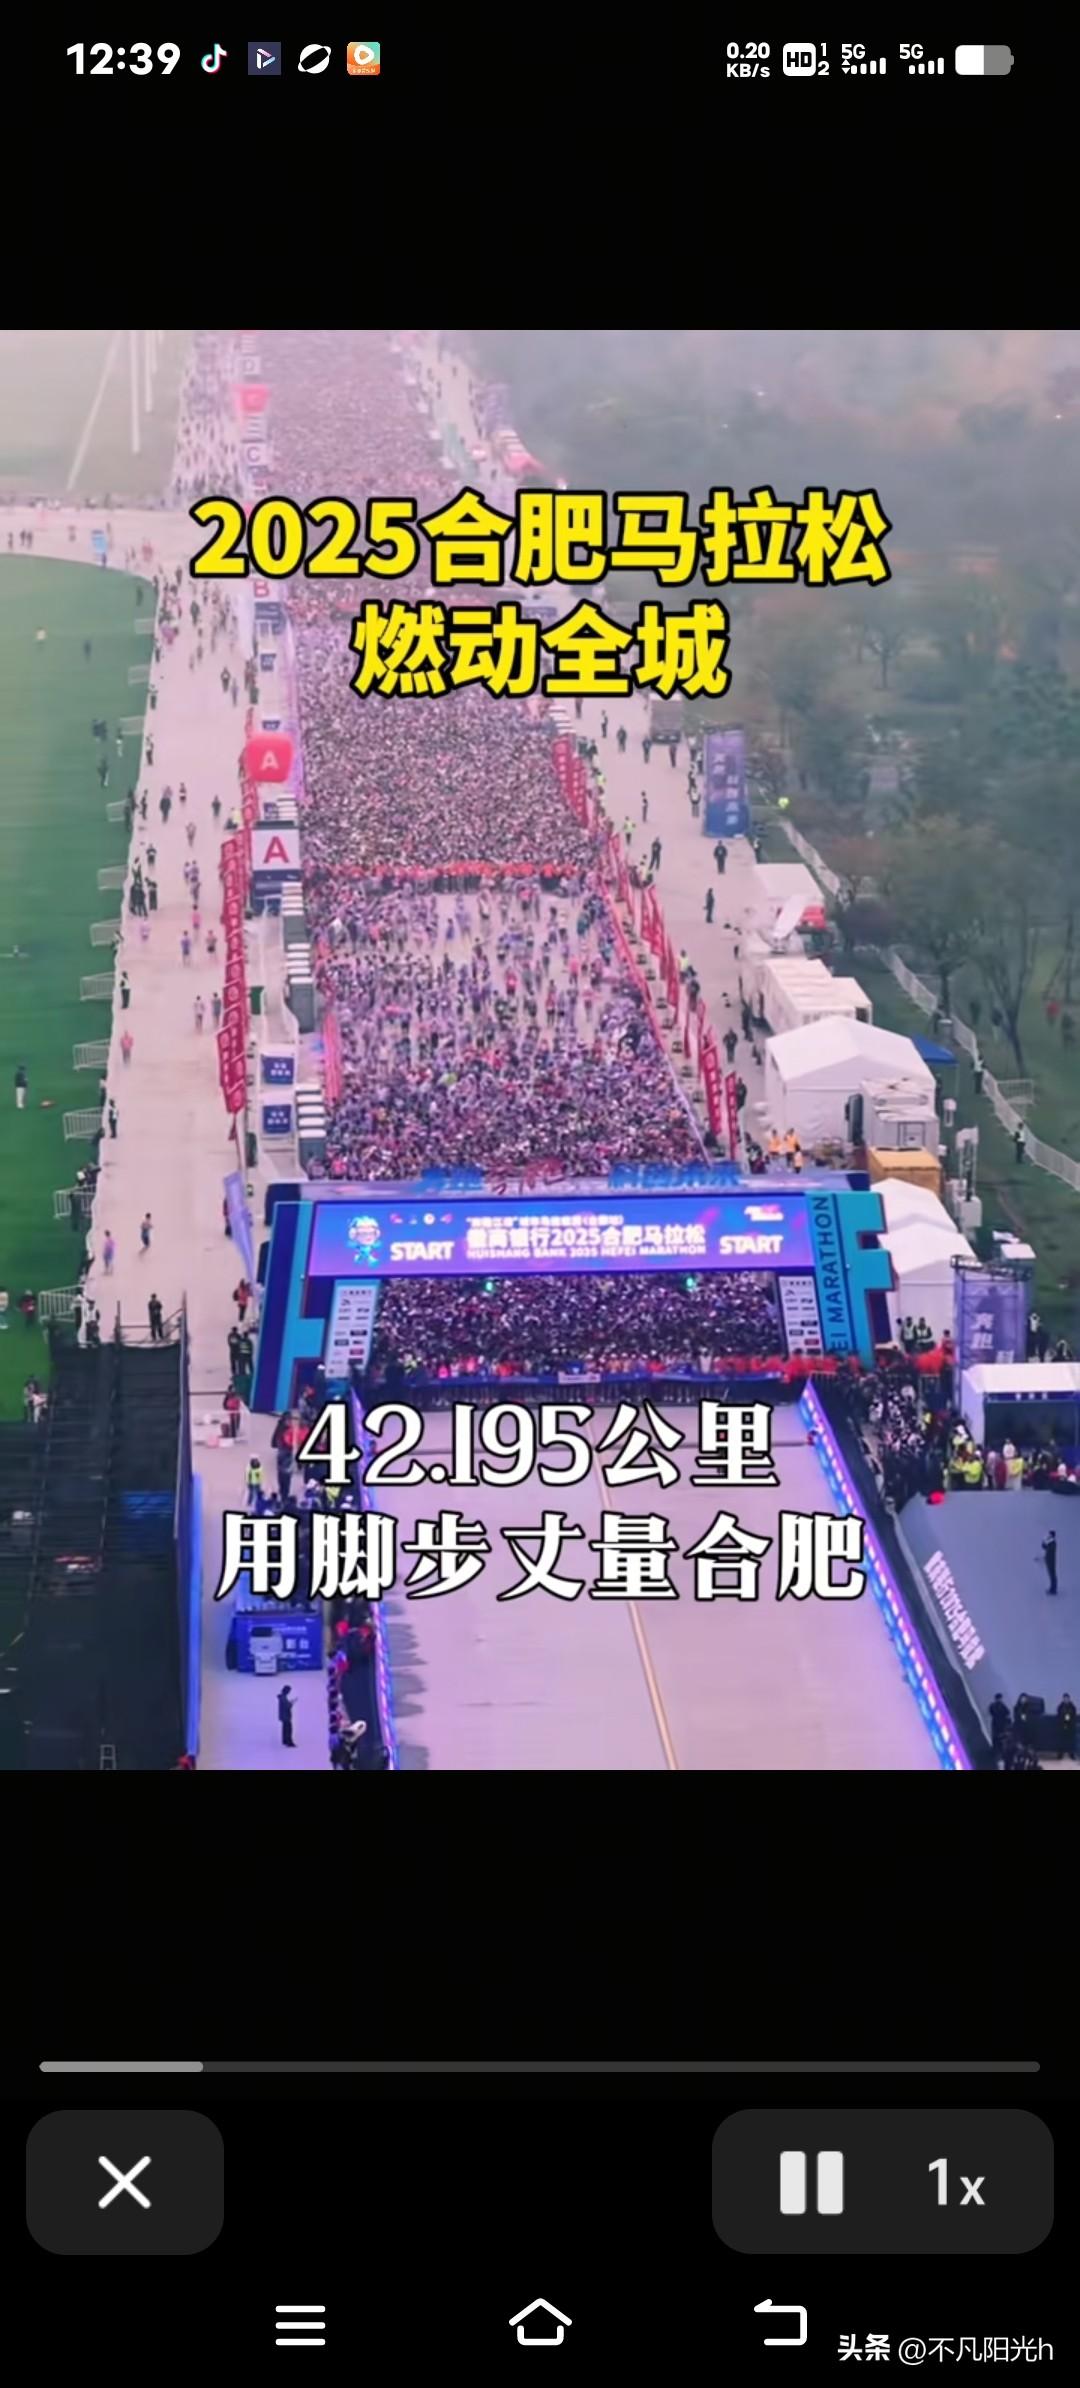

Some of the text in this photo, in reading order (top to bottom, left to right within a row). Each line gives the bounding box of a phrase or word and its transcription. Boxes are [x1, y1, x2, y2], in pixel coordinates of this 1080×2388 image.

[66, 42, 181, 76] 12:39
[726, 42, 771, 59] 0.20
[786, 51, 812, 68] HD
[841, 43, 866, 59] 5G
[899, 43, 924, 59] 5G
[726, 63, 771, 78] KB/s
[260, 752, 278, 770] A
[262, 835, 289, 864] A
[390, 1240, 455, 1261] START
[720, 1235, 784, 1254] START
[813, 1196, 845, 1324] MARATHON
[928, 2158, 986, 2207] 1x
